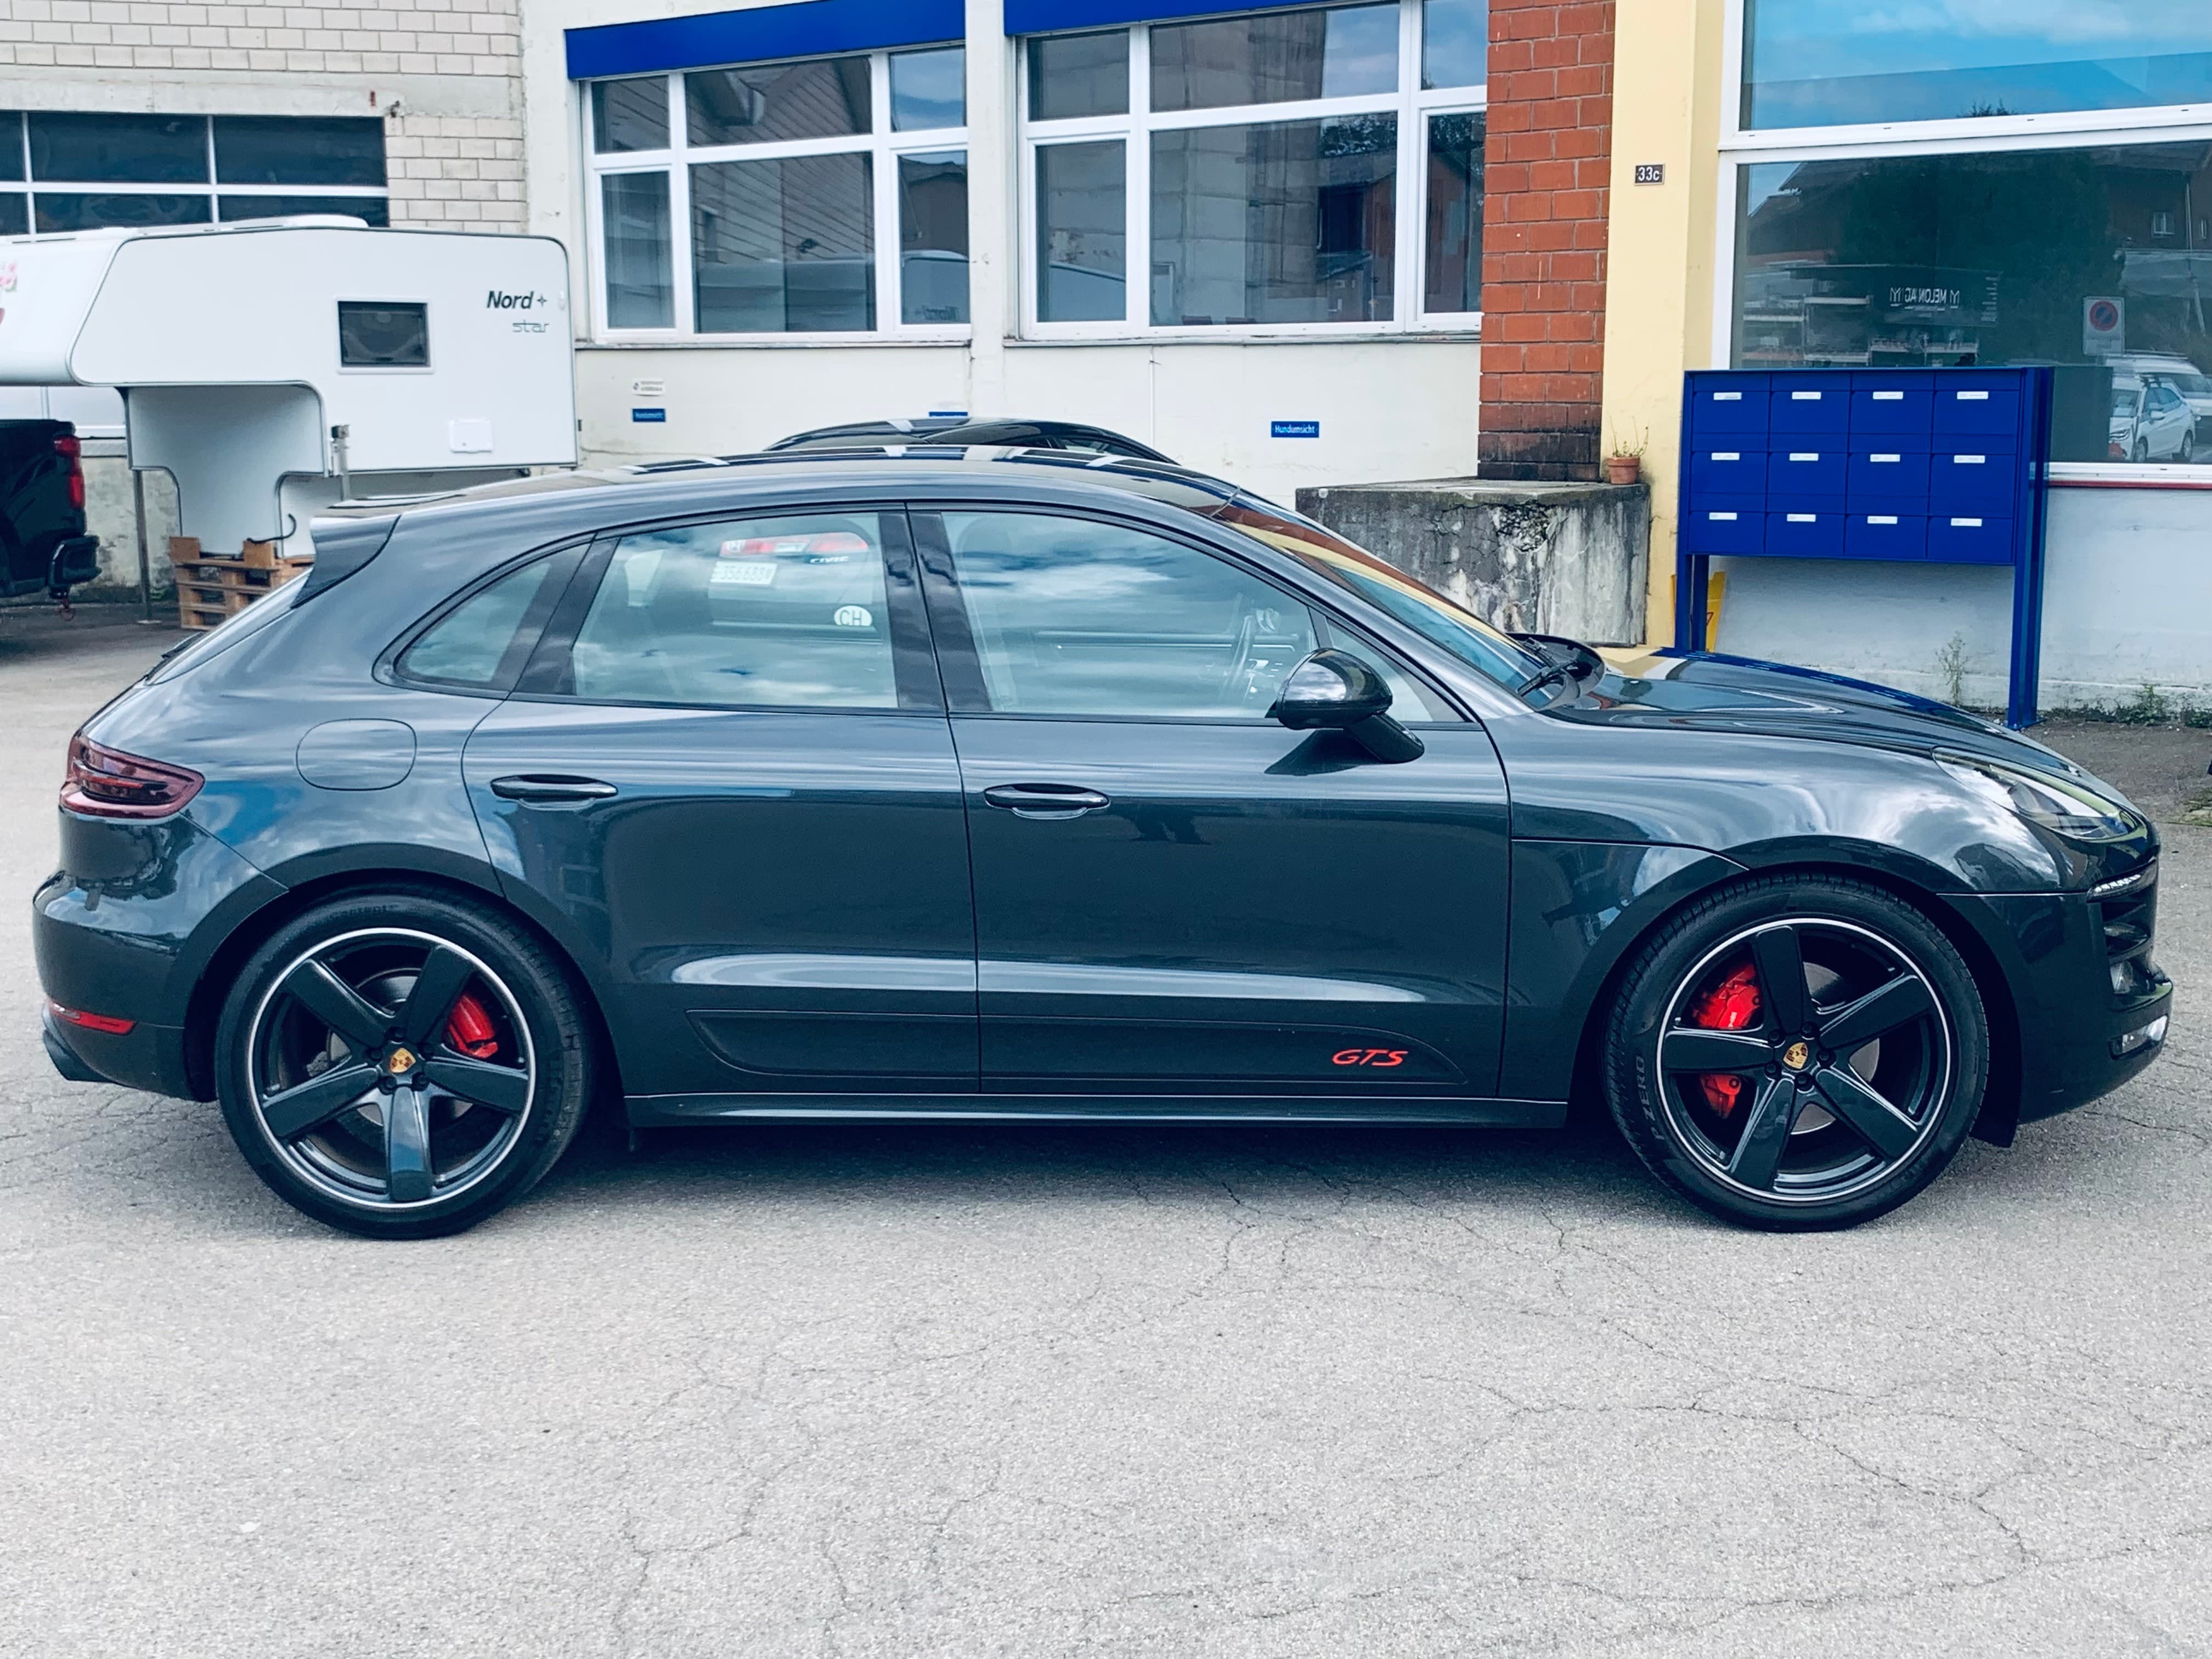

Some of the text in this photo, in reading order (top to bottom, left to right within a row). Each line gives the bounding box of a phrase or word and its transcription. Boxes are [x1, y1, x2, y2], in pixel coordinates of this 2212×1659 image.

[1638, 166, 1660, 181] 33c
[487, 290, 534, 309] Nord
[512, 319, 549, 332] star
[839, 610, 862, 627] CH
[1332, 1049, 1409, 1066] GTS
